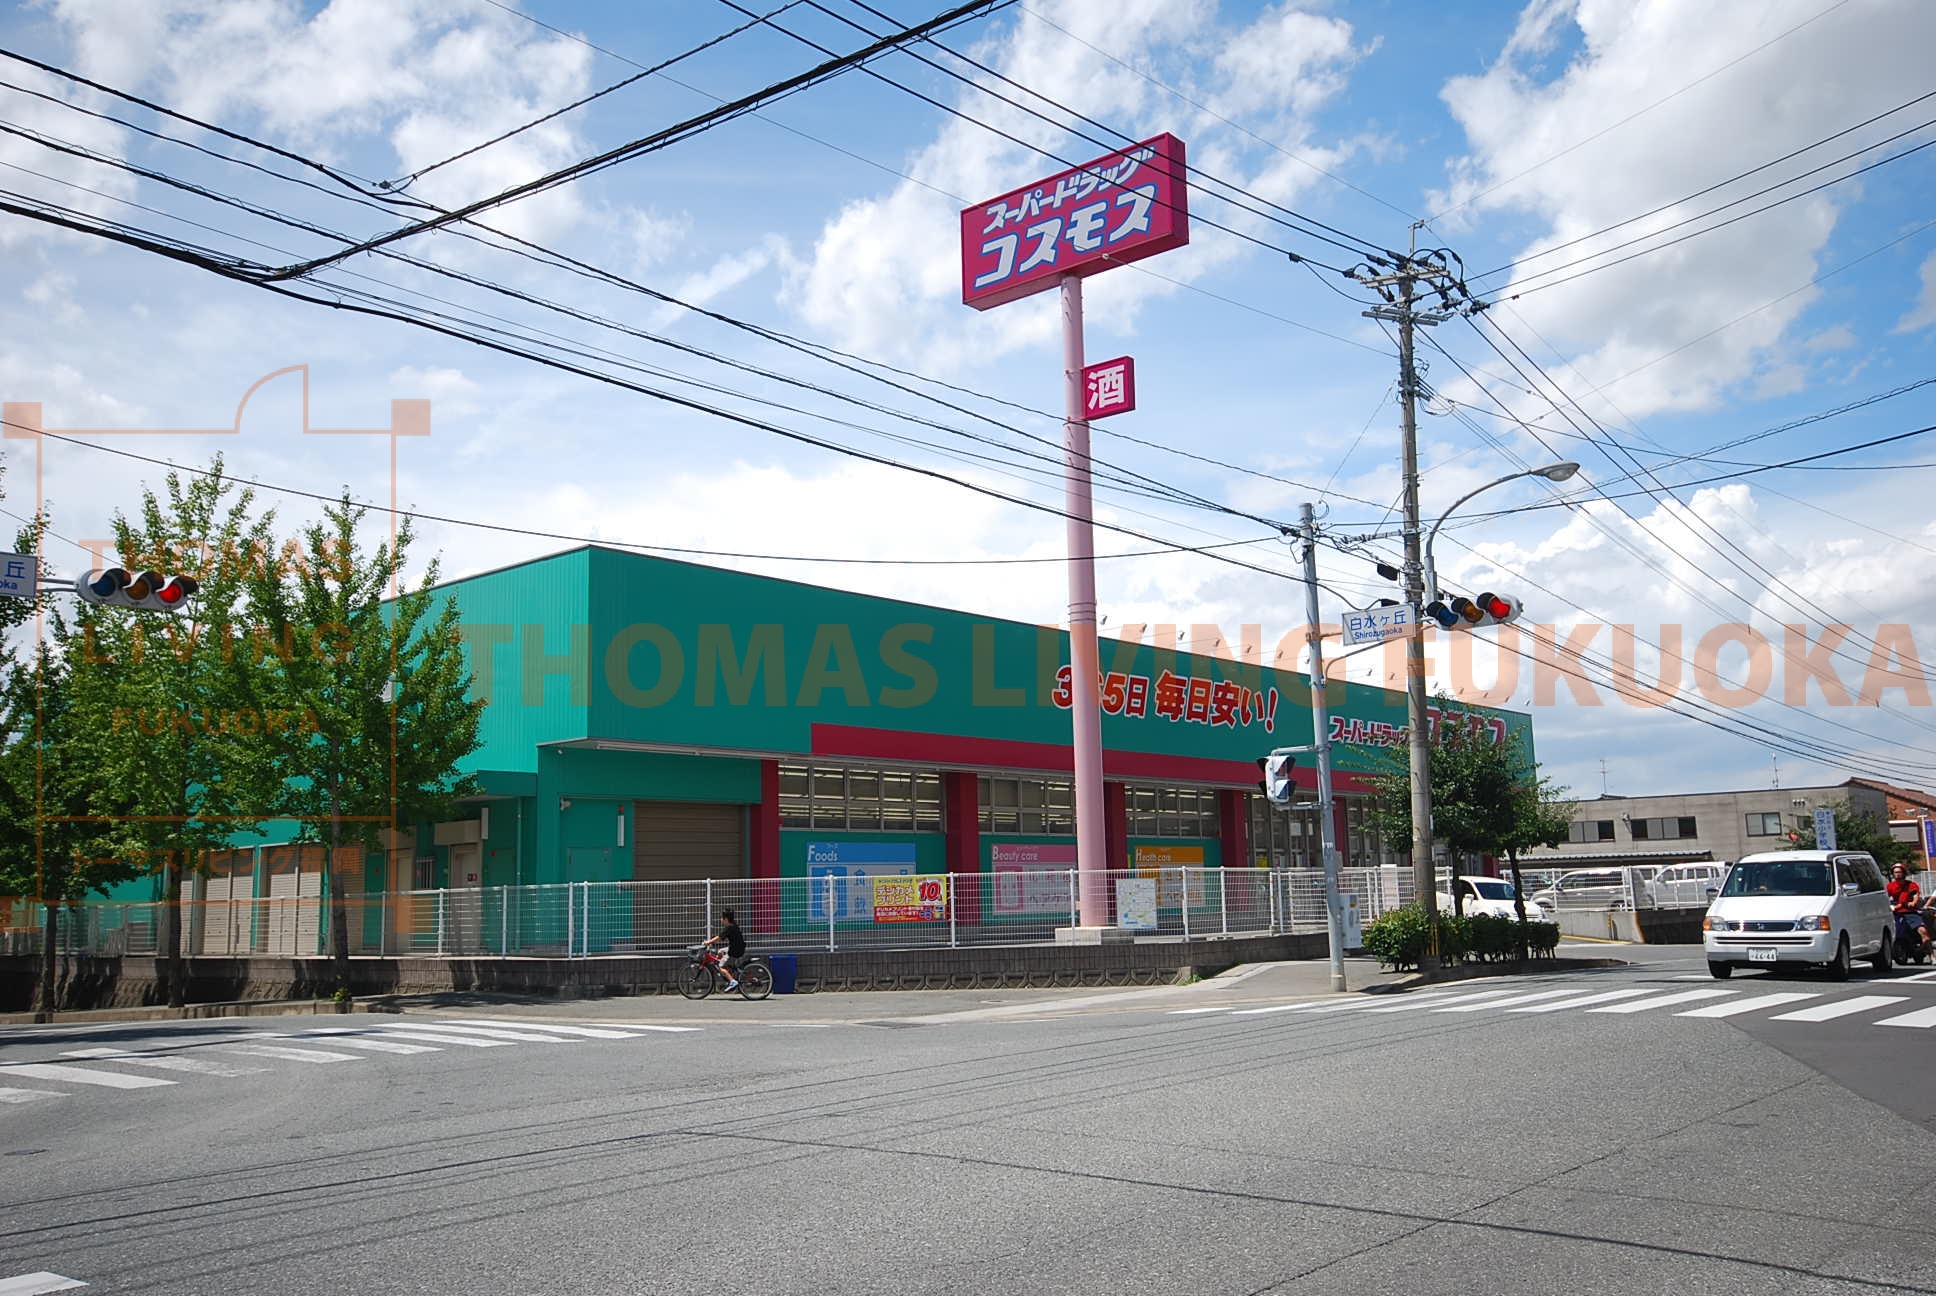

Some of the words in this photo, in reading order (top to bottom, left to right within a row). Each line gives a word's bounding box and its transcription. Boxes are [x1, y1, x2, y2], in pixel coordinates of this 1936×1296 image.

[982, 146, 1155, 235] スーパードラッグ
[974, 184, 1157, 290] コスモス
[1088, 364, 1125, 411] 酒
[1354, 627, 1403, 640] Shirozugaoka
[1052, 665, 1149, 719] 35日
[807, 844, 839, 862] Foods
[992, 845, 1019, 862] Beauty
[1021, 852, 1039, 861] care
